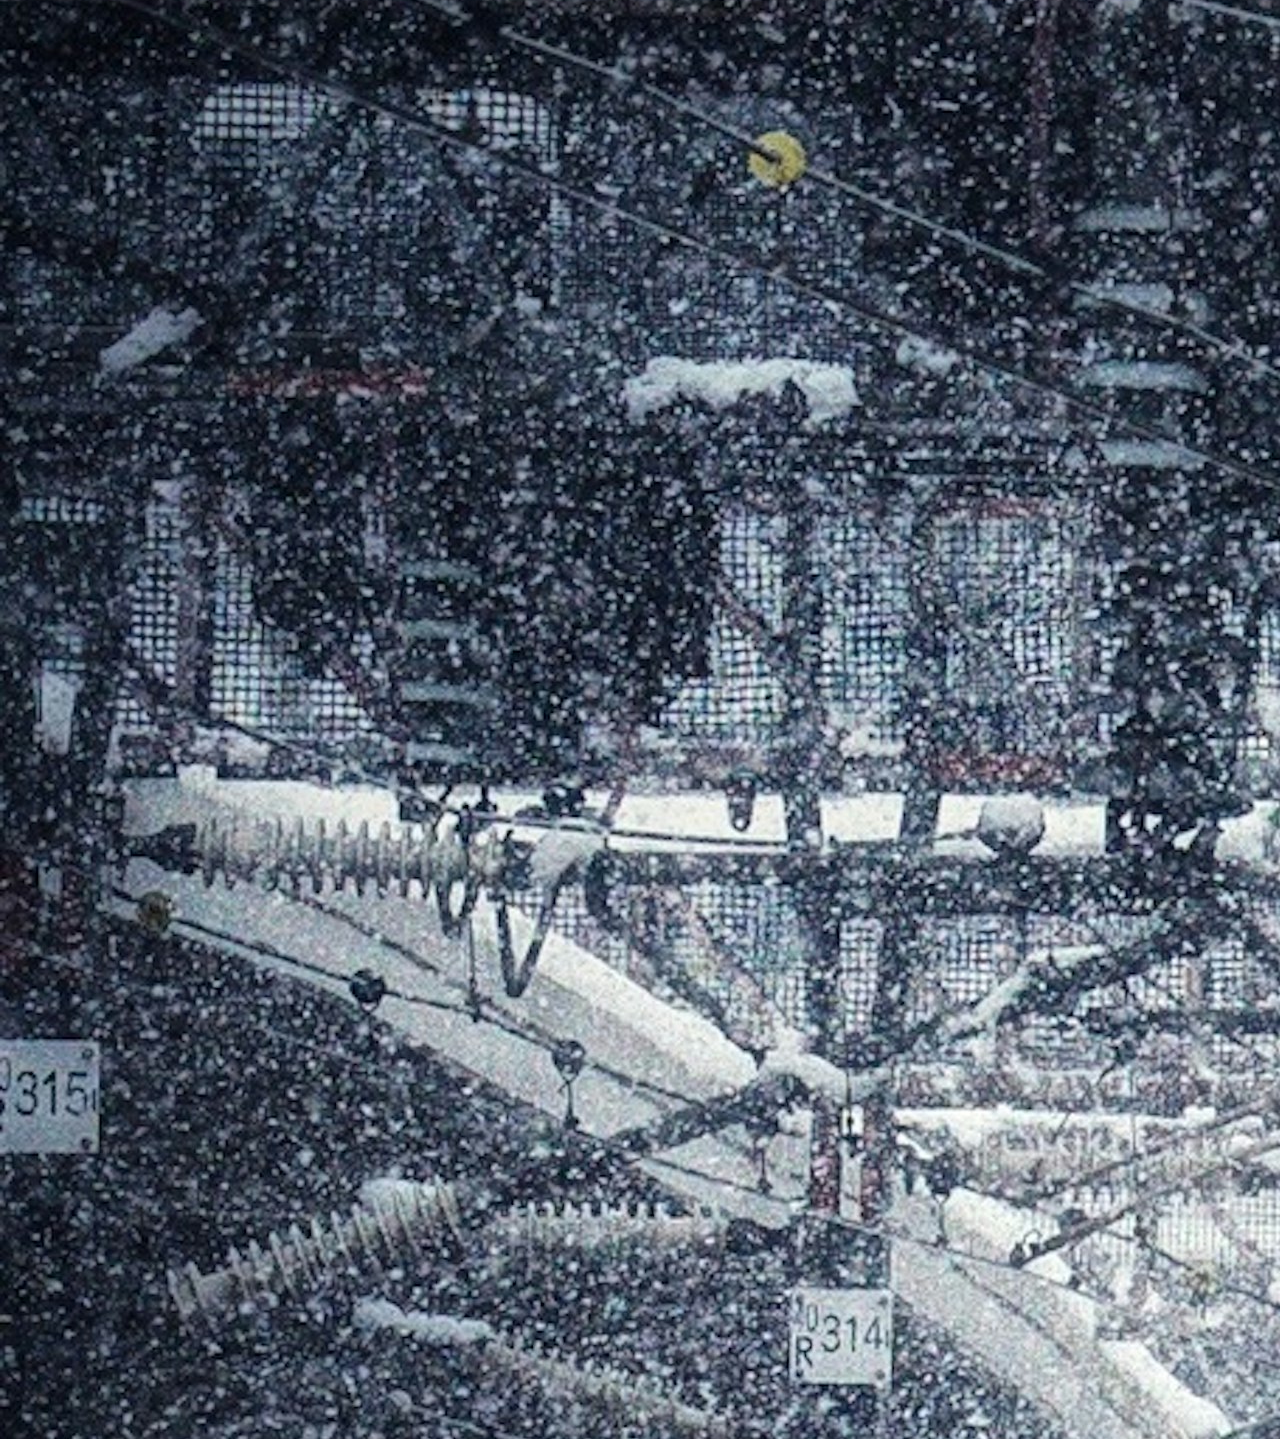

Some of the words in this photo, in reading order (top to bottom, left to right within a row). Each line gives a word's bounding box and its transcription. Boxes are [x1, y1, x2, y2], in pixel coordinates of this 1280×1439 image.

[14, 1068, 88, 1117] 315
[795, 1335, 814, 1368] R
[821, 1311, 884, 1354] 314
